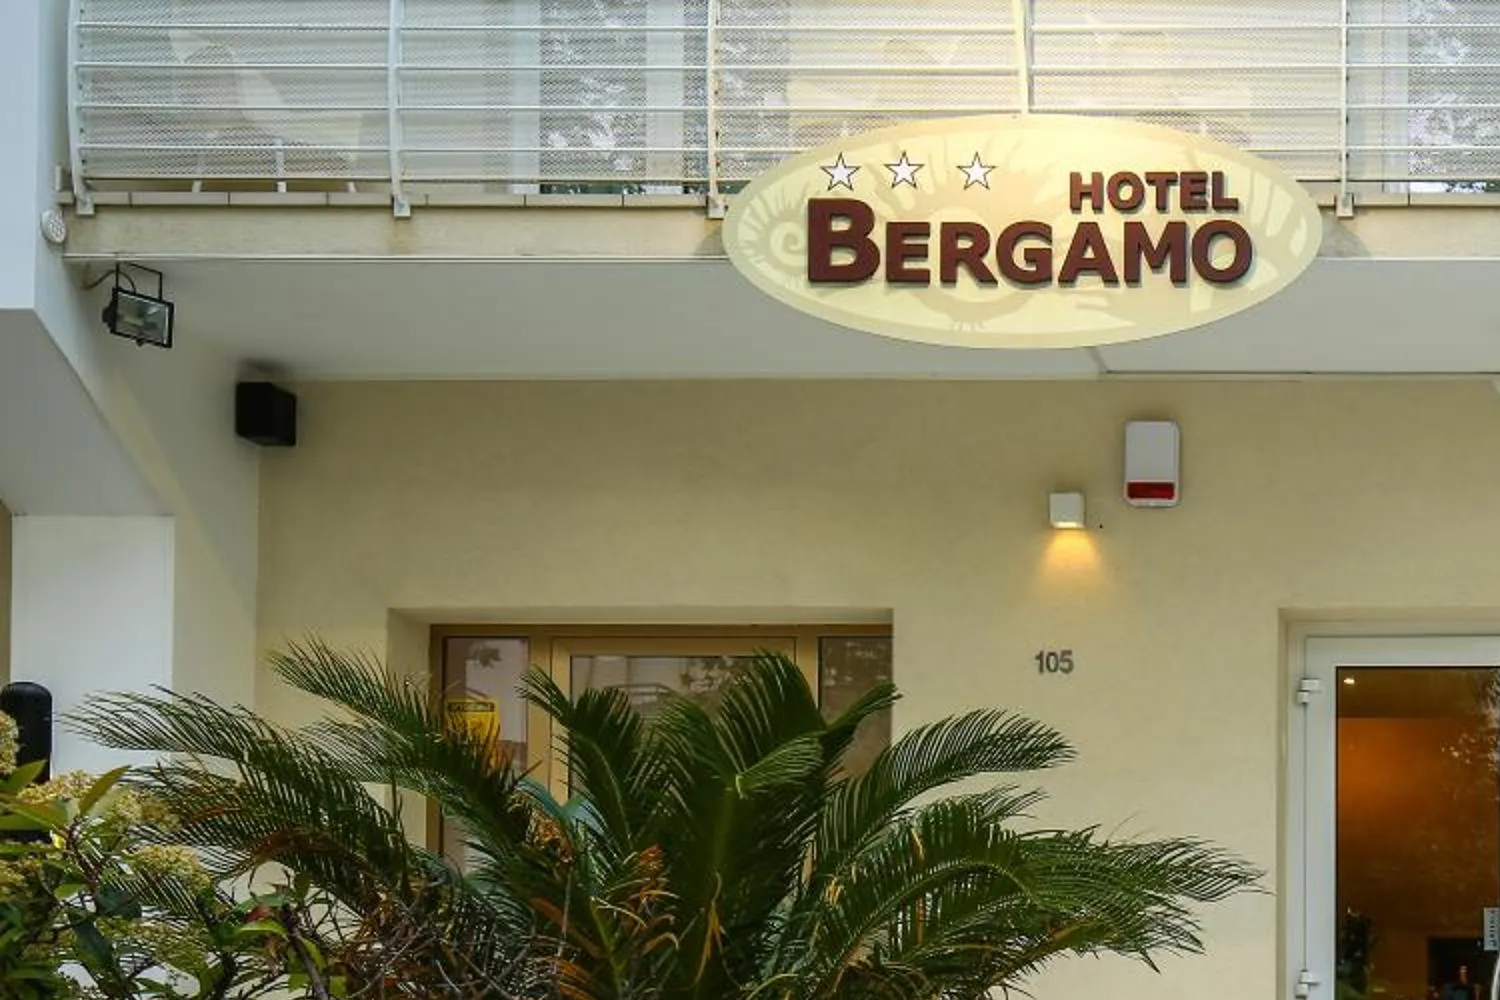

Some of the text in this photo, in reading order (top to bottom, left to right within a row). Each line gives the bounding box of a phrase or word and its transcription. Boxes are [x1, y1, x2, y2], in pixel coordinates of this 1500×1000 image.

[1068, 169, 1240, 213] HOTEL
[805, 196, 1255, 287] BERGAMO
[1034, 649, 1075, 674] 105
